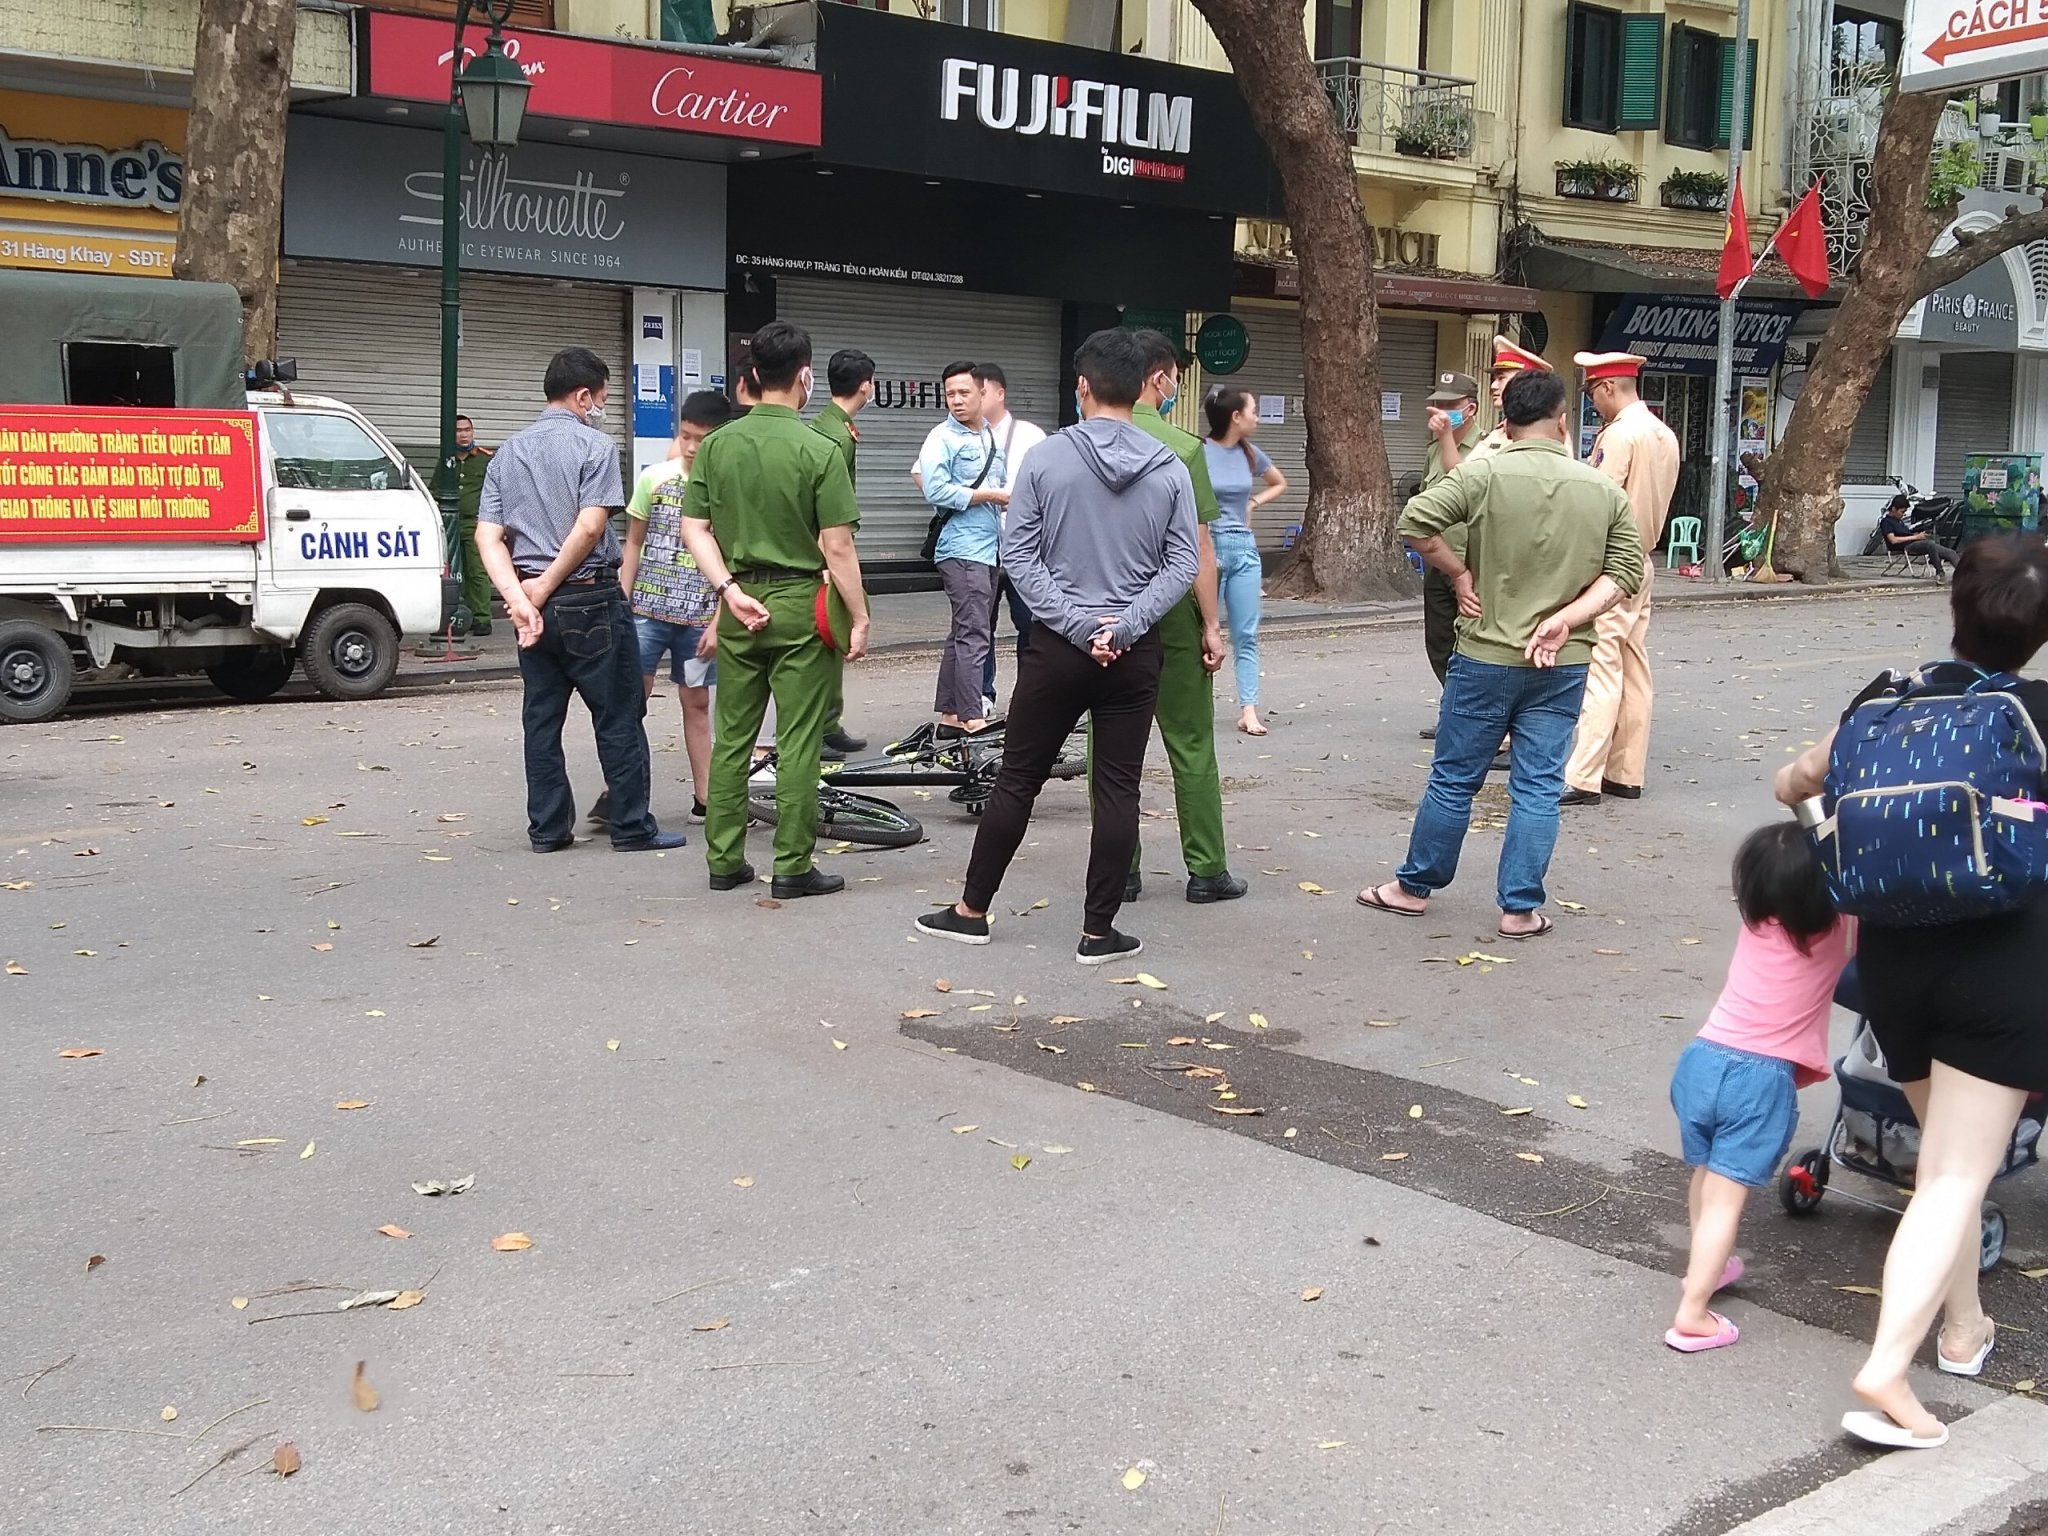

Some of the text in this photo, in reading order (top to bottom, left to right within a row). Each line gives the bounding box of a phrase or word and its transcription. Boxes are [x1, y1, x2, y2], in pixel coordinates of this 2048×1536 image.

[1948, 0, 2029, 38] CÁCH
[652, 67, 788, 128] Cartier
[941, 58, 1192, 153] FUJIFILM
[399, 152, 625, 241] Silhouette
[1, 239, 19, 257] 31
[23, 241, 67, 264] Hàng
[70, 245, 113, 268] Khay
[128, 249, 169, 268] SĐT:
[399, 237, 474, 256] AUTHEIC
[551, 250, 588, 265] SINCE
[751, 255, 761, 265] 35
[761, 256, 784, 267] HÀNG
[814, 261, 840, 272] TRÀNG
[868, 266, 889, 277] HOÀN
[1622, 305, 1720, 339] BOOKING
[1931, 293, 2014, 321] PARIS FRANCE
[1954, 321, 1980, 333] BEAUTY
[1626, 340, 1667, 357] TOURIST
[874, 380, 949, 409] UJIFI
[0, 426, 232, 457] ÂN DÂN PHƯỜNG TRÀNG TIỀN QUYẾT TÂM
[20, 460, 54, 486] CÔNG
[55, 461, 79, 486] TÁC
[81, 457, 109, 486] ĐẢM
[111, 457, 136, 487] BẢO
[136, 462, 166, 491] TRẬT
[166, 465, 183, 491] TỰ
[184, 462, 201, 487] ĐÔ
[202, 466, 225, 492] THỊ,
[0, 493, 211, 523] GIAO THÔNG VÀ VỆ SINH MÔI TRƯỜNG
[301, 522, 421, 560] CẢNH SÁT
